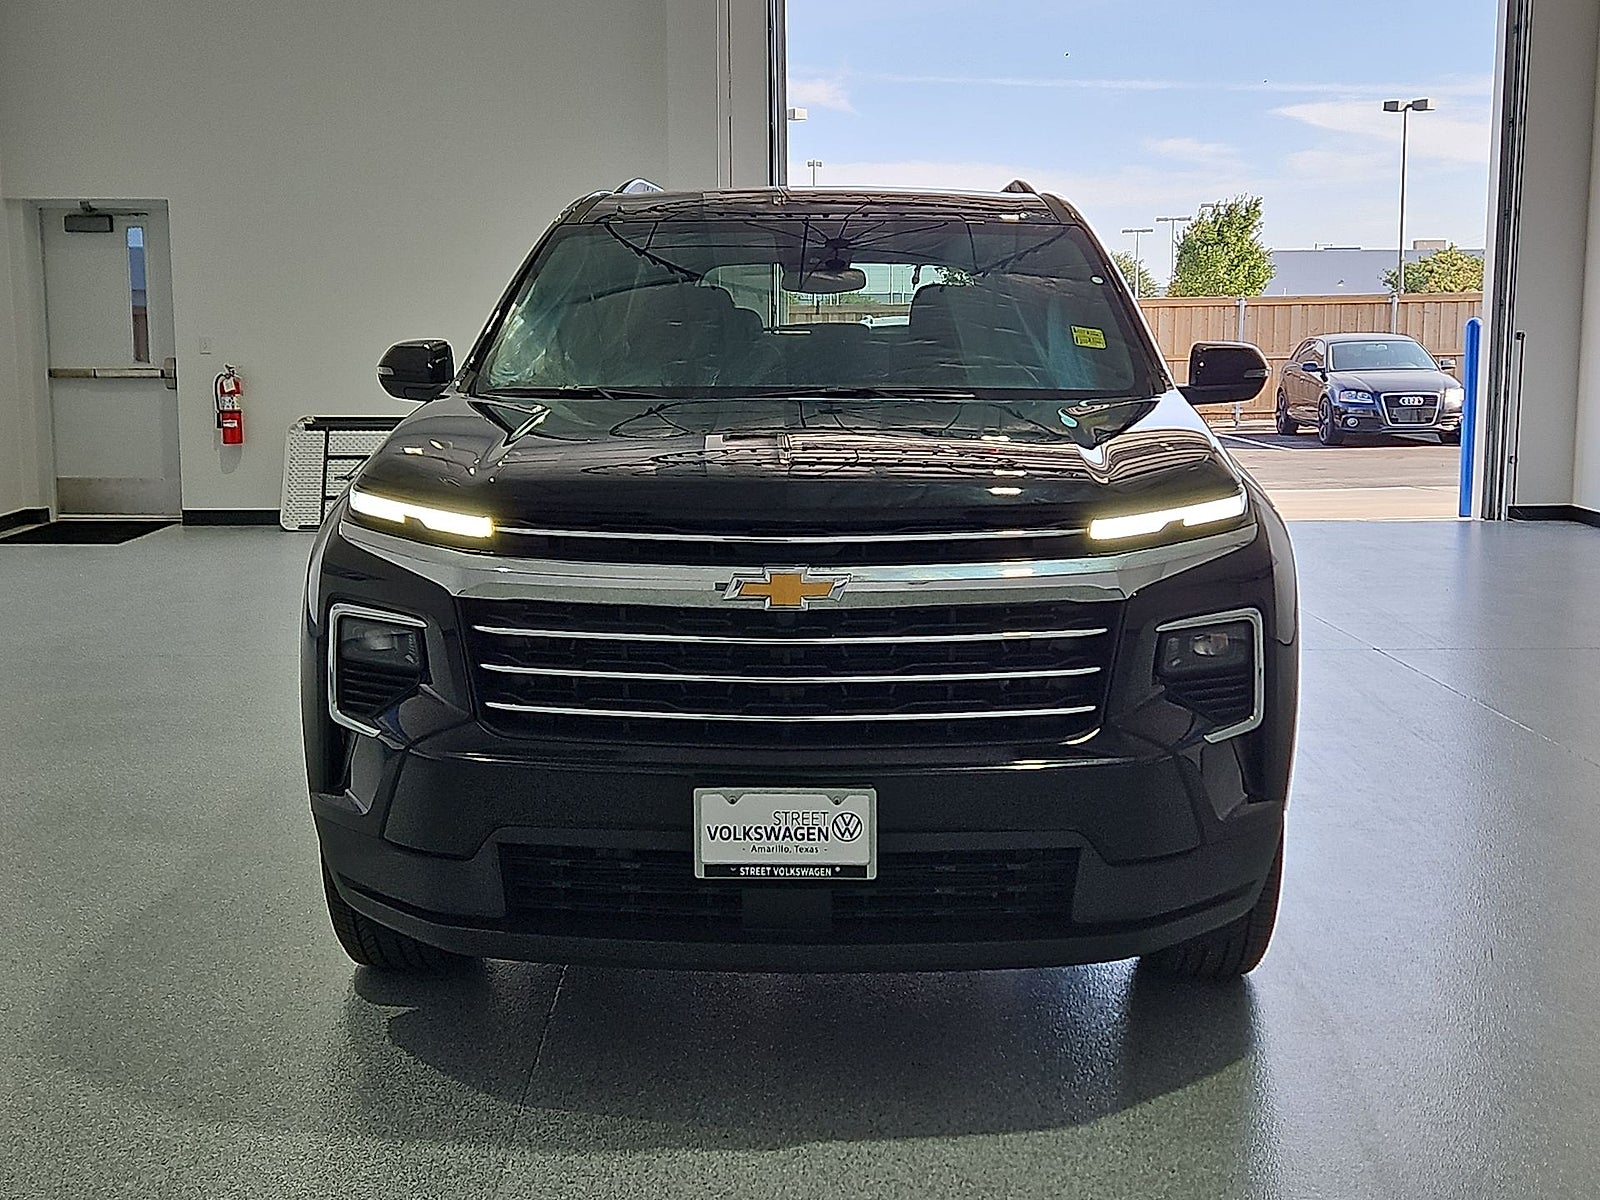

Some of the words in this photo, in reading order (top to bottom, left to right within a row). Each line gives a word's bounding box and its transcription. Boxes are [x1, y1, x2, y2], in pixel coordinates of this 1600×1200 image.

[772, 811, 829, 826] STREET
[706, 825, 830, 842] VOLKSWAGEN
[750, 844, 792, 854] Amarillo,
[793, 844, 819, 854] Texas
[739, 866, 771, 876] STREET
[772, 866, 832, 876] VOLKSWAGEN
